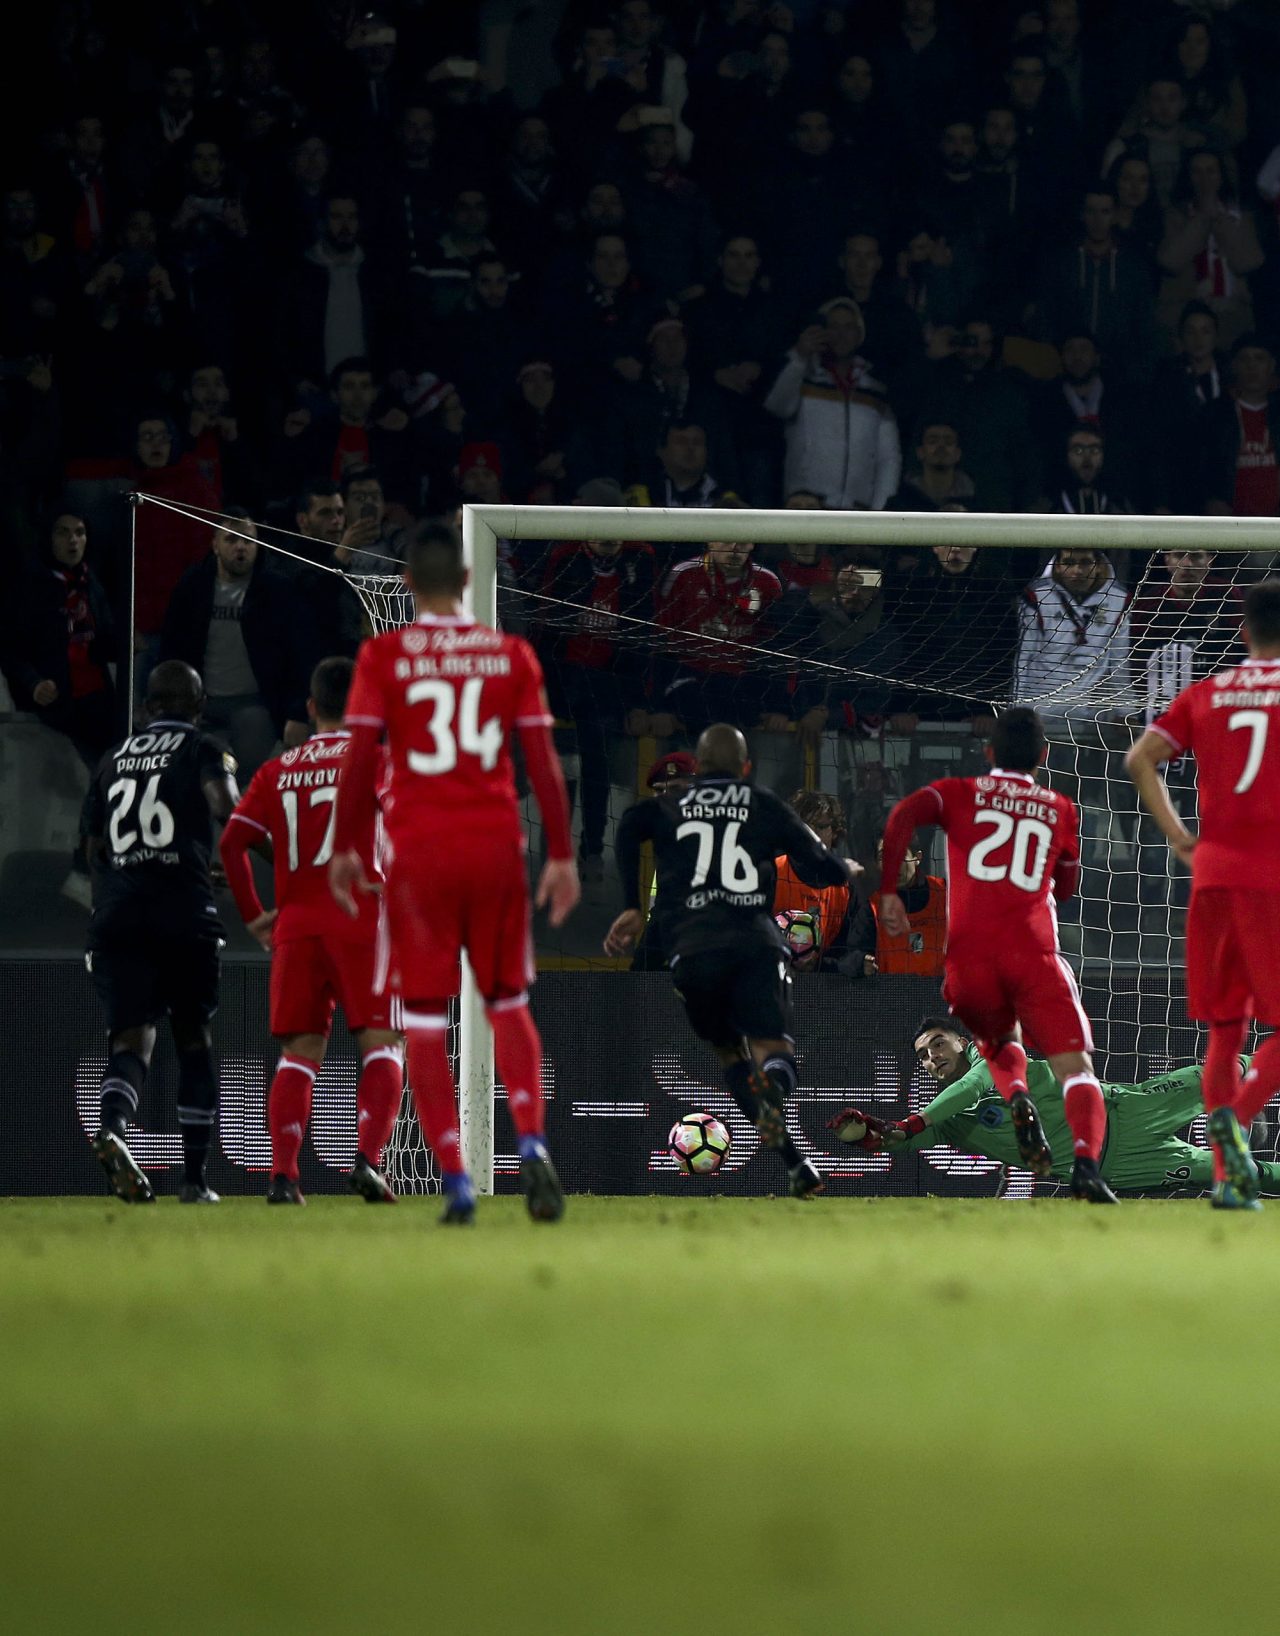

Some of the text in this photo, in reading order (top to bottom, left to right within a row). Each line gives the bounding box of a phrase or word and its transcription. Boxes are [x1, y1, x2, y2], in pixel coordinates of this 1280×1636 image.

[112, 730, 187, 761] JOM
[117, 752, 173, 775] PRINCE
[405, 674, 505, 777] 34
[1227, 708, 1269, 794] 7
[107, 773, 175, 854] 26
[281, 785, 340, 873] 17
[678, 783, 752, 807] JOM
[681, 804, 749, 823] GASPAR
[676, 820, 760, 894] 76
[967, 808, 1053, 893] 20
